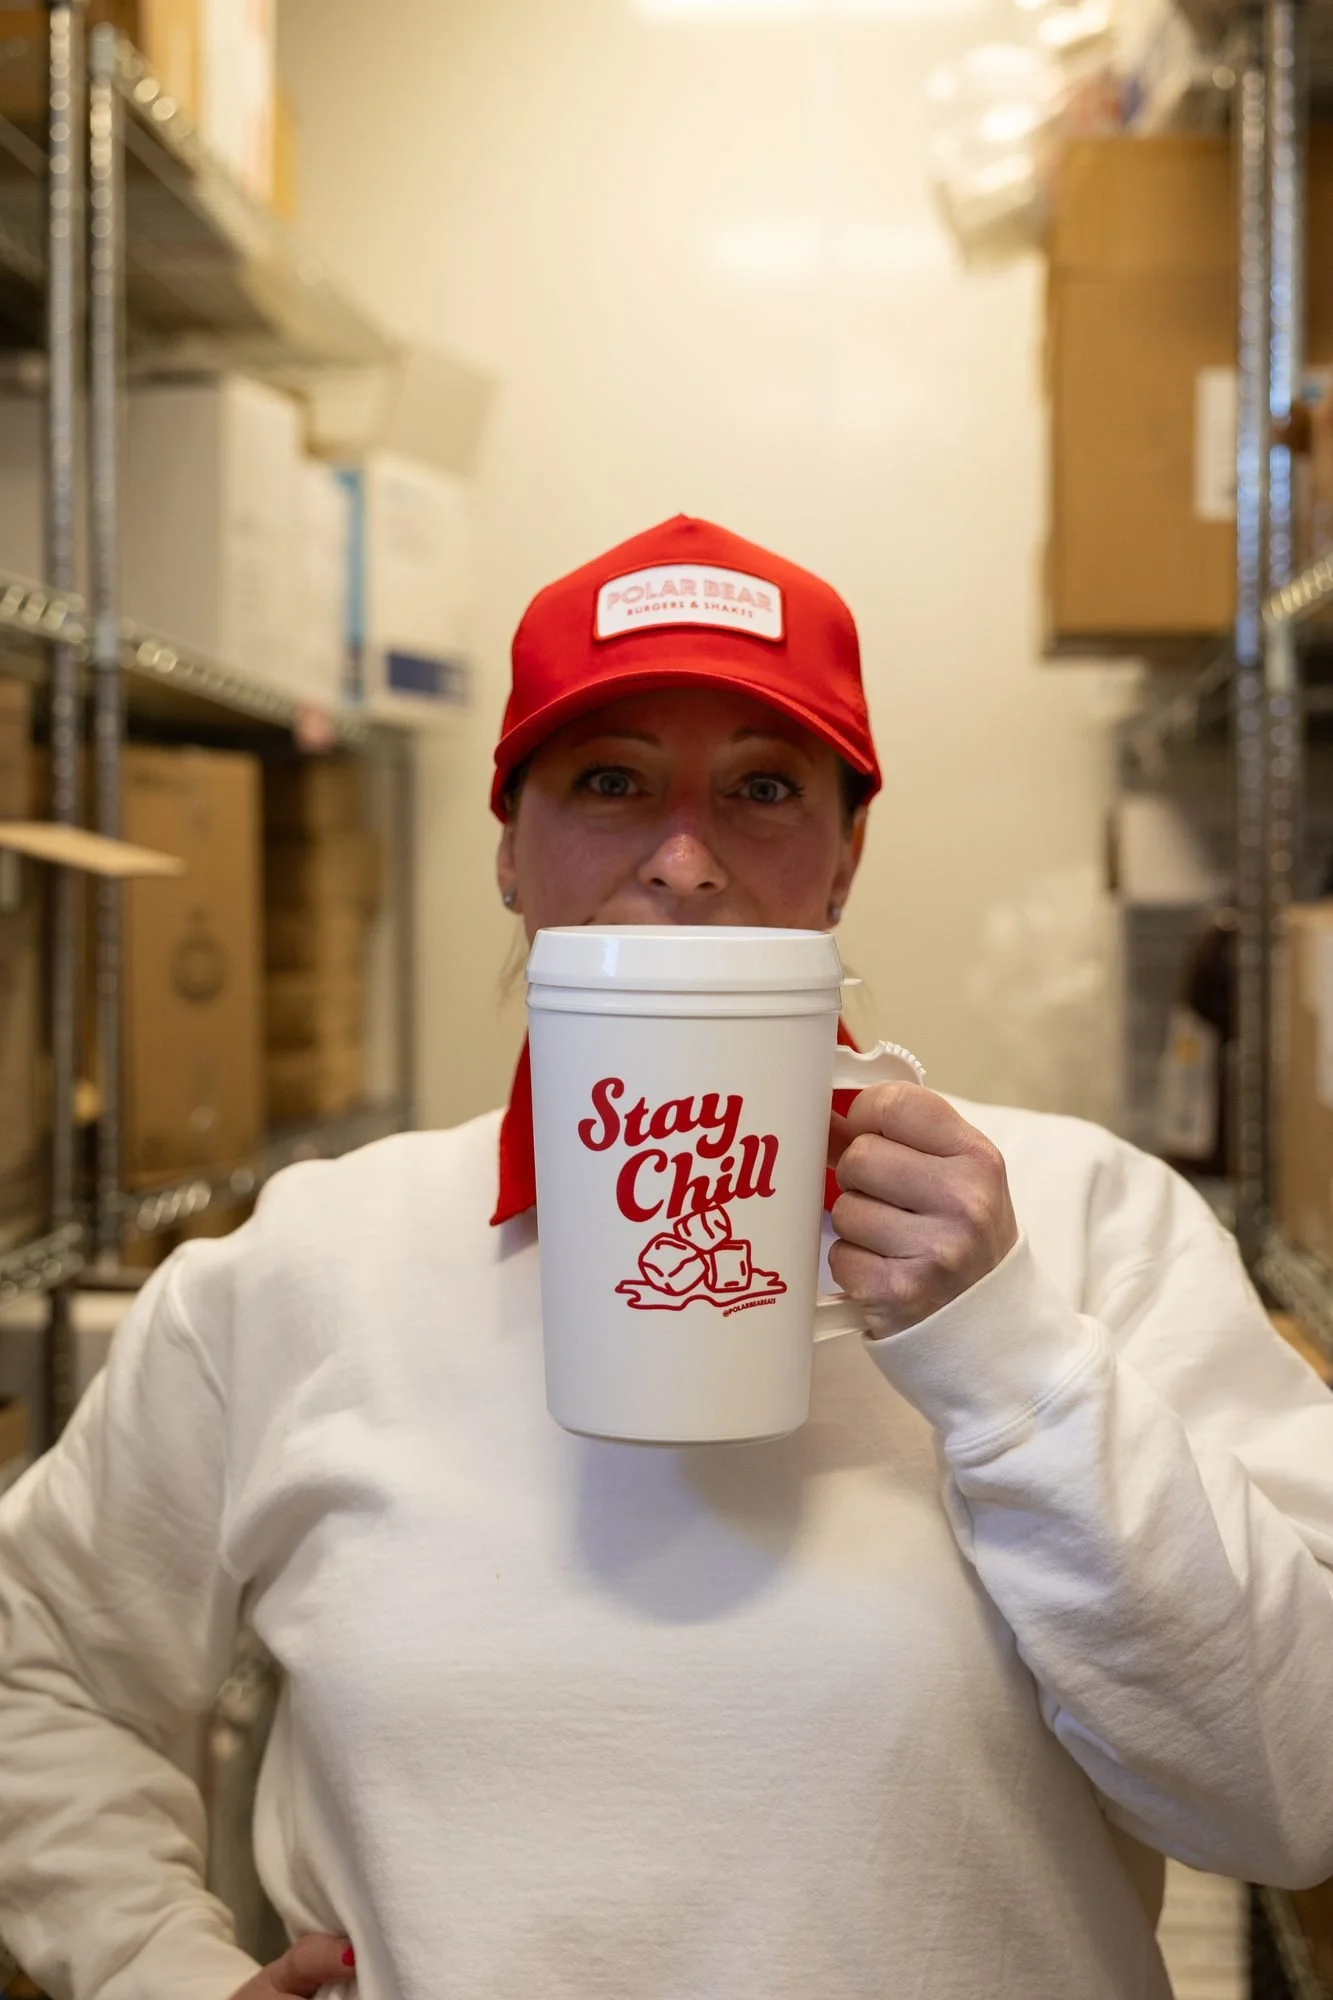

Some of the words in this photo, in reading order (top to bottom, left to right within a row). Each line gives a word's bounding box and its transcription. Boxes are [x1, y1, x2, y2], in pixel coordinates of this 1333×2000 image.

[607, 578, 698, 611] POLAR
[703, 579, 773, 613] BEAR
[627, 601, 685, 617] BURGERS
[689, 600, 699, 610] &
[704, 602, 754, 619] SHAKES
[577, 1077, 744, 1159] Stay
[616, 1134, 780, 1223] Chill
